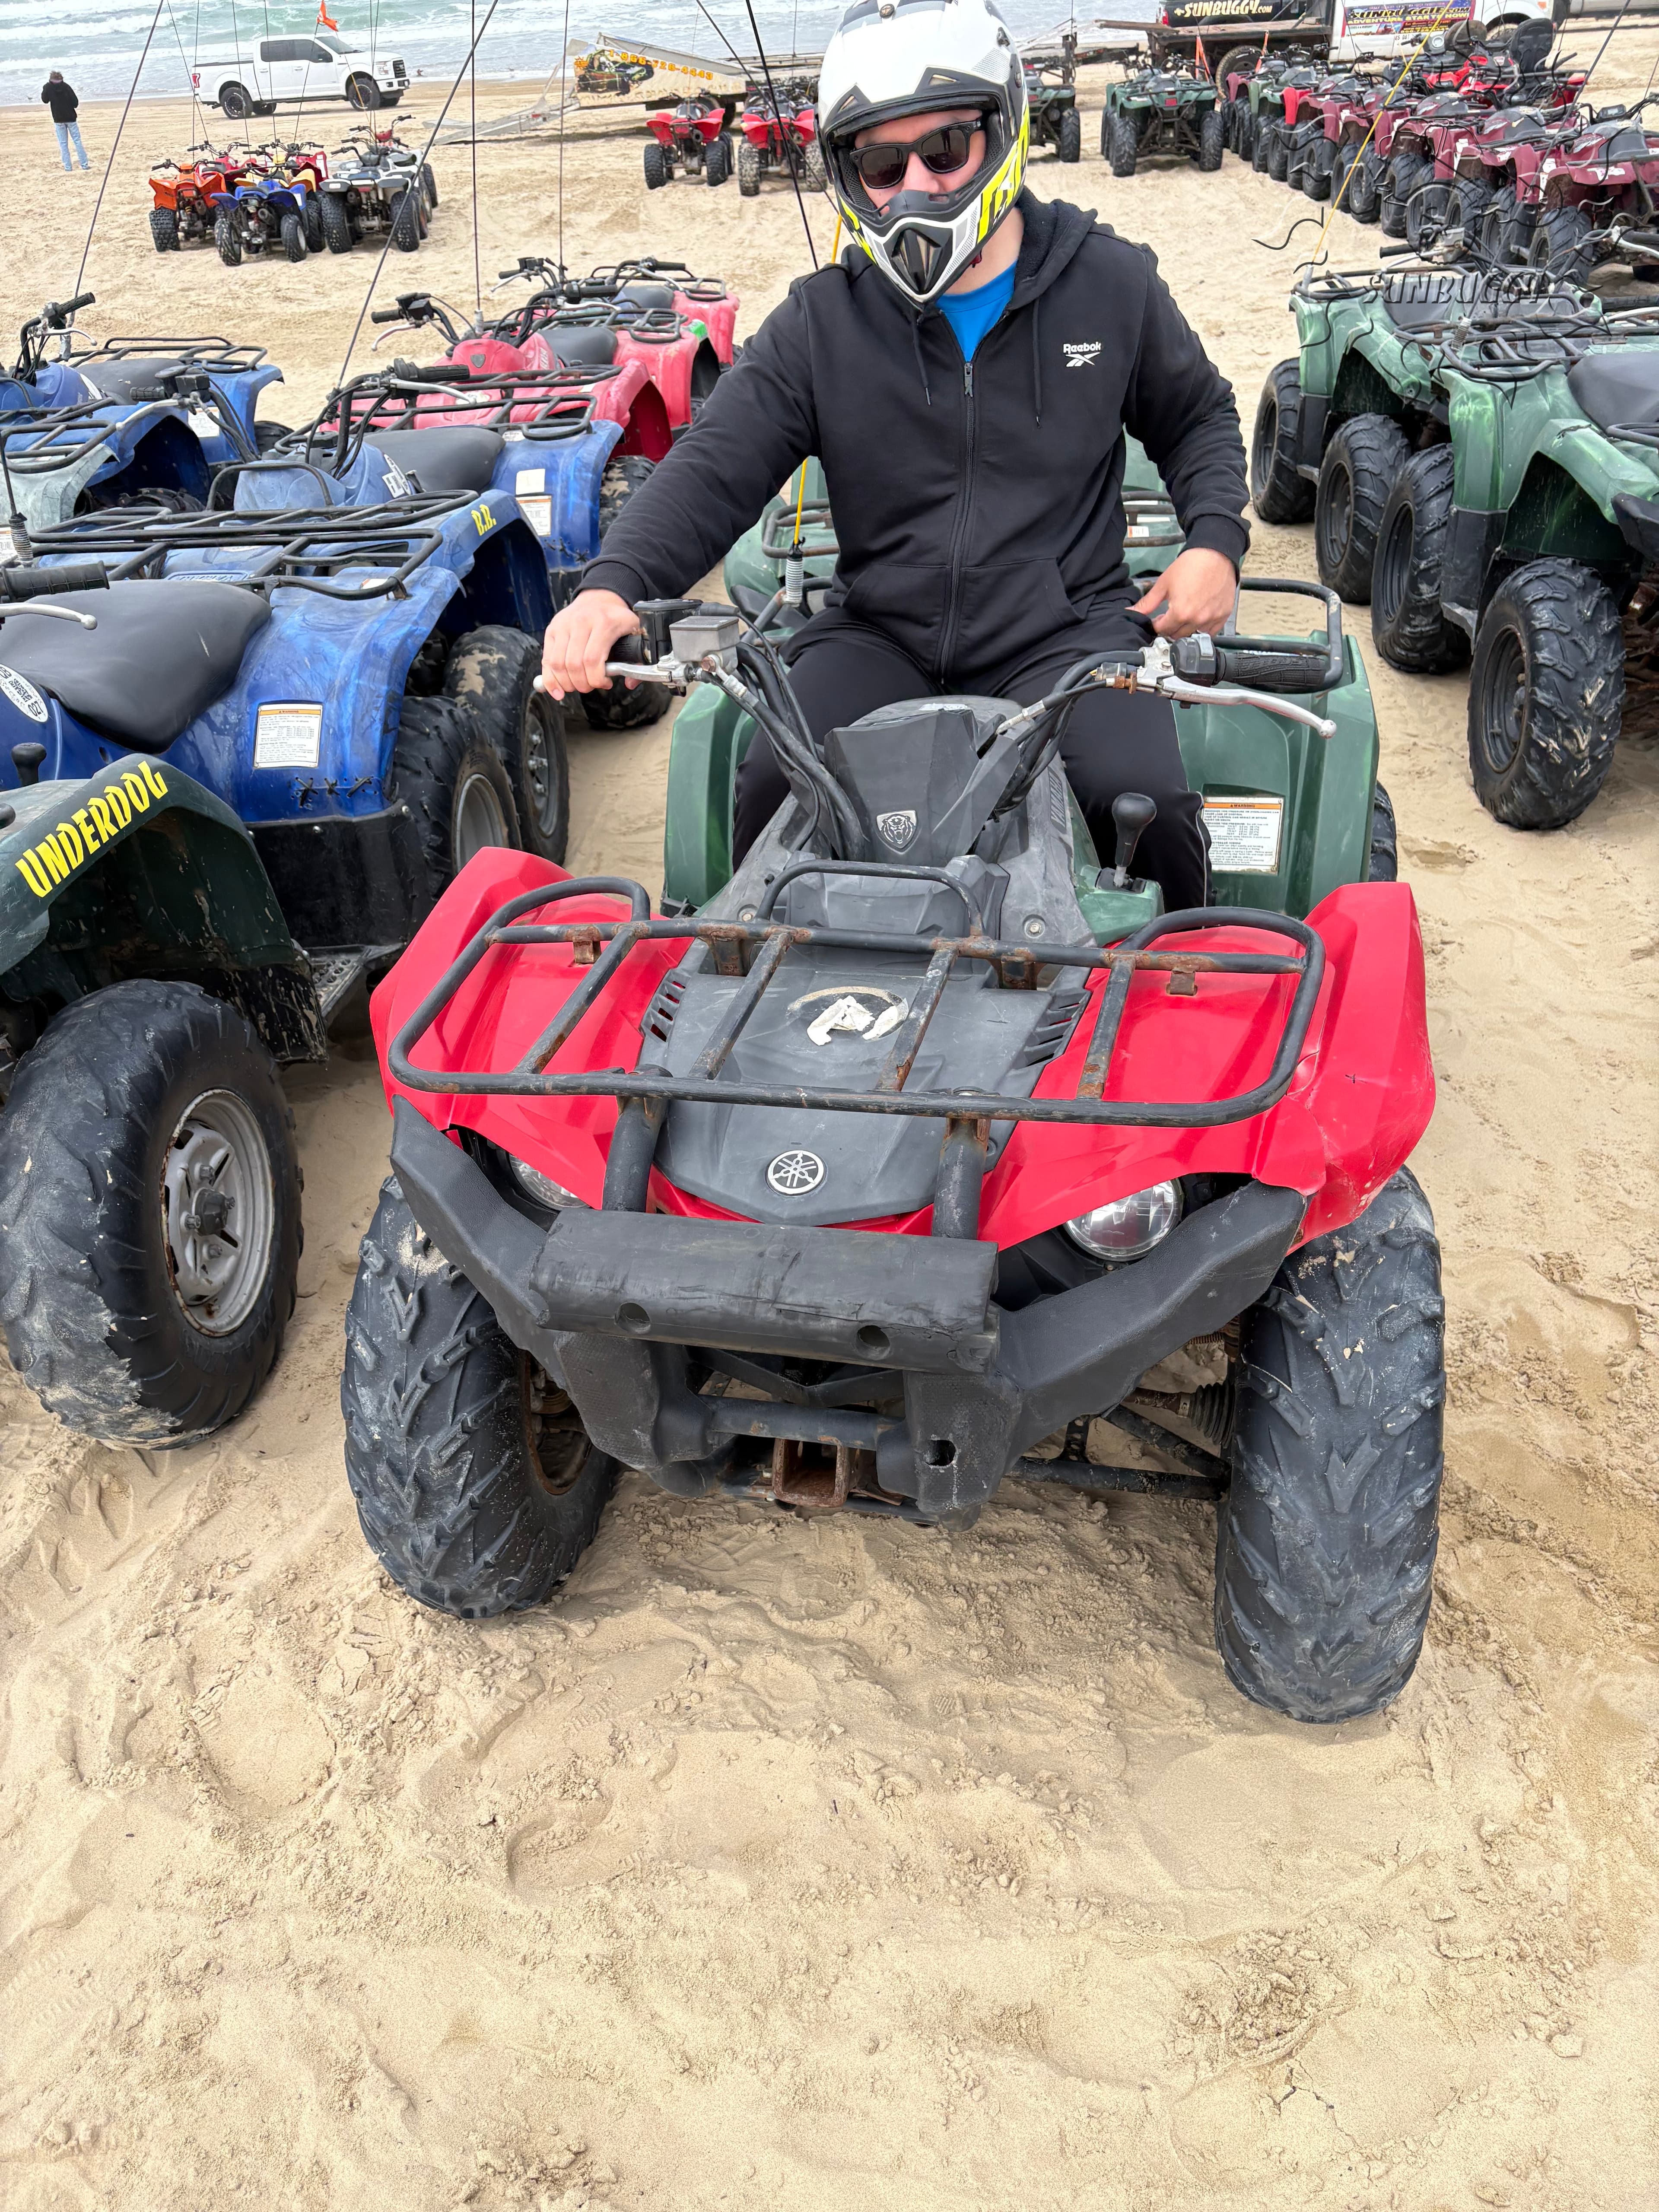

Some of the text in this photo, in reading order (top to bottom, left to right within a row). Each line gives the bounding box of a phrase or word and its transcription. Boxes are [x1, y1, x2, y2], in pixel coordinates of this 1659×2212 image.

[1063, 342, 1101, 354] Reebok
[471, 504, 497, 536] B.B.
[28, 700, 44, 717] 027
[14, 760, 168, 898] UNDERDOG
